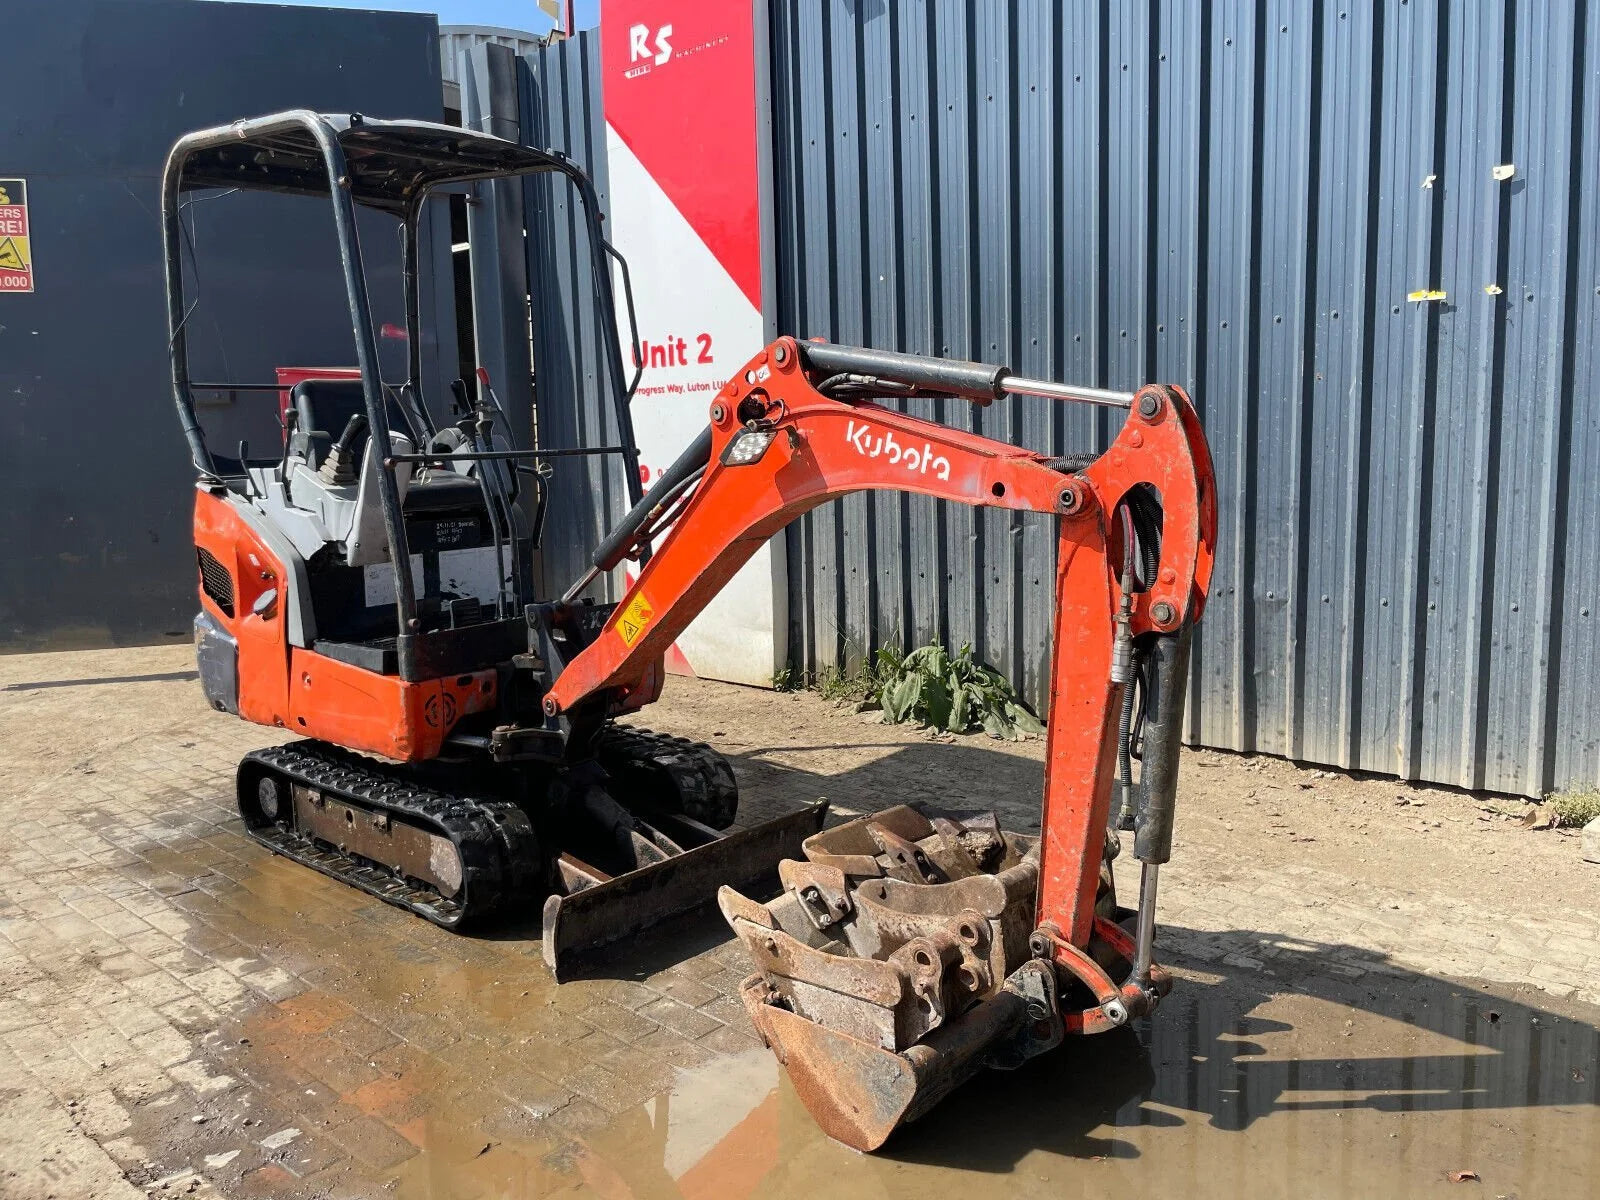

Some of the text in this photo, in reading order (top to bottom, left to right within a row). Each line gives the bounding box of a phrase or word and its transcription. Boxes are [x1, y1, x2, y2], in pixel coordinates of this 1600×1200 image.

[630, 23, 673, 66] RS
[632, 332, 713, 369] Unit 2
[687, 381, 711, 392] Luton
[846, 420, 951, 481] Kubota
